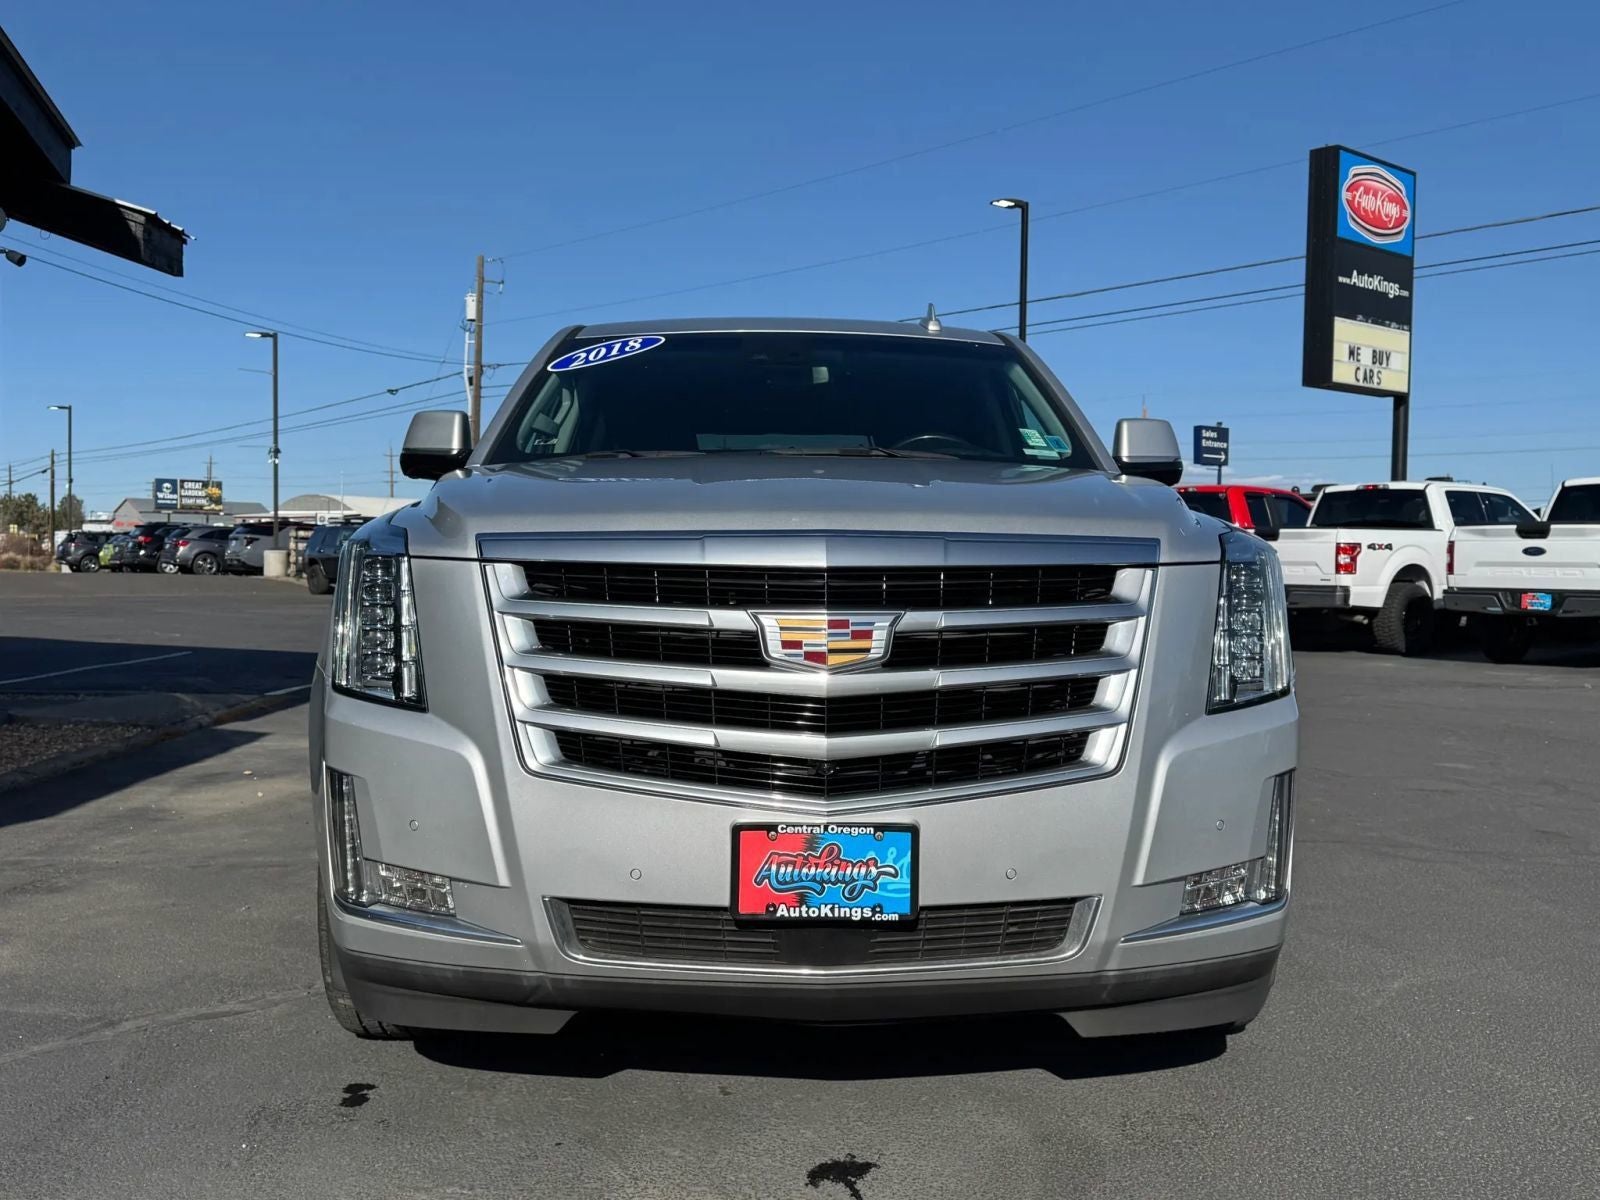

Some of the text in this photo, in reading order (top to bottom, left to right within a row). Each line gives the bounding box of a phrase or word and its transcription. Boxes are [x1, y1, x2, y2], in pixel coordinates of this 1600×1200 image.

[569, 338, 643, 368] 2018
[1348, 343, 1392, 367] WE BUY
[1355, 367, 1382, 385] CARS
[1202, 429, 1217, 438] Sales
[1202, 439, 1227, 448] Entrance
[183, 481, 203, 489] GREAT
[777, 824, 874, 837] Central Oregon
[776, 904, 899, 921] AutoKings.com
